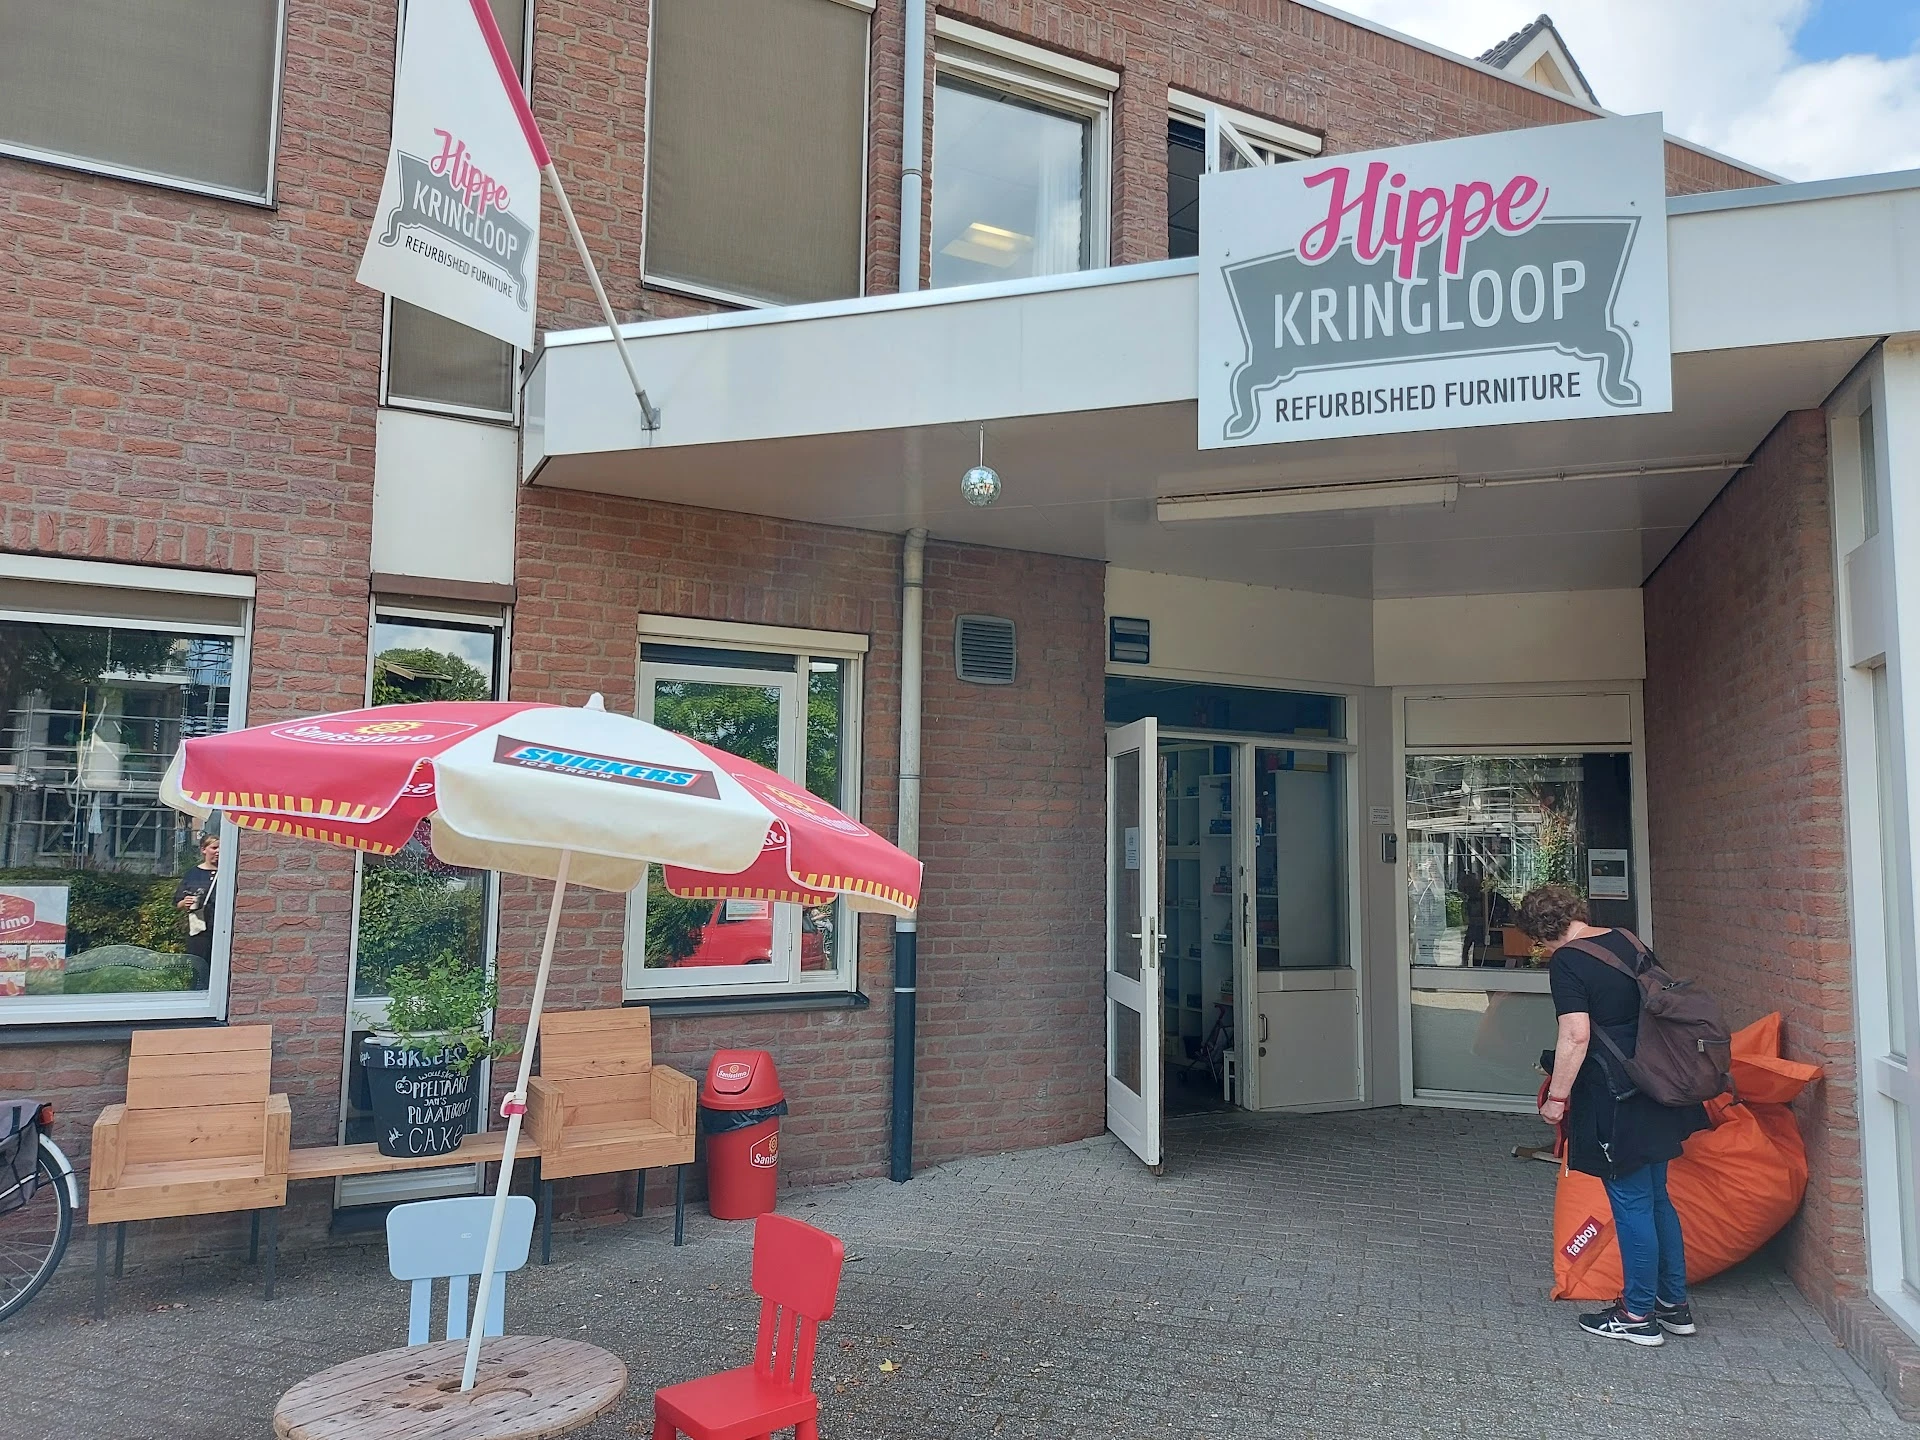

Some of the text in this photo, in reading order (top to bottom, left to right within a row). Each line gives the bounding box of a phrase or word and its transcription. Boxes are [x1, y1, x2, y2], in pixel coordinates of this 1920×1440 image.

[430, 128, 511, 216] Hippe
[412, 179, 519, 260] KRINGLOOP
[1299, 162, 1550, 280] Hippe
[404, 235, 513, 299] REFURBISHED FURNITURE
[1273, 260, 1587, 349] KRINGLOOP
[1275, 372, 1582, 423] REFURBISHED FURNITURE
[284, 726, 436, 743] Sanissimo
[516, 747, 695, 786] SNICKERS
[519, 760, 613, 780] ICE CREAM
[1566, 1223, 1598, 1257] fatboy
